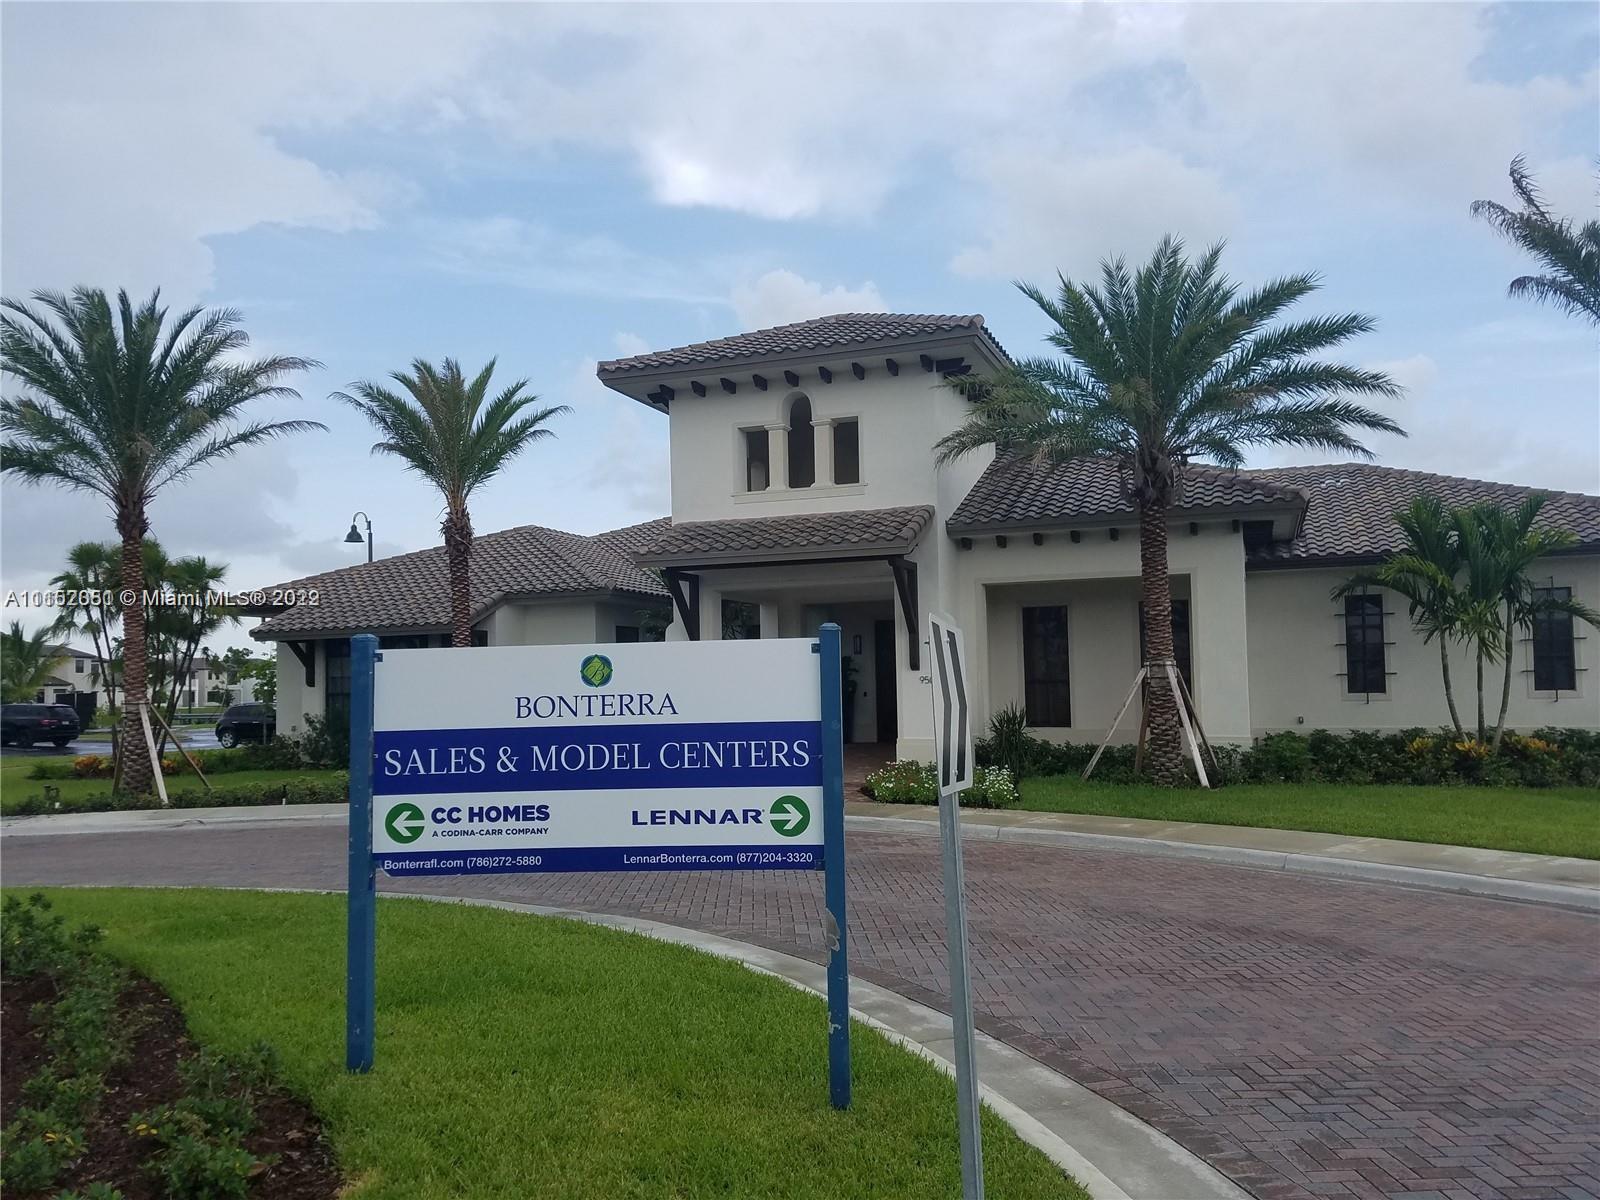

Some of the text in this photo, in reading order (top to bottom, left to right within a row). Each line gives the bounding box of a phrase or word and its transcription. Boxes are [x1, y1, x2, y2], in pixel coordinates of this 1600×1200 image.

[515, 692, 679, 718] BONTERRA
[384, 739, 810, 777] SALES & MODEL CENTERS
[431, 804, 550, 825] CC HOMES
[631, 808, 764, 826] LENNAR
[431, 827, 549, 837] A CODINA-CARR COMPANY
[384, 856, 542, 870] Bonterrafl.com (786)272-5880
[623, 852, 813, 865] LennarBonterra.com (877)204-3320
